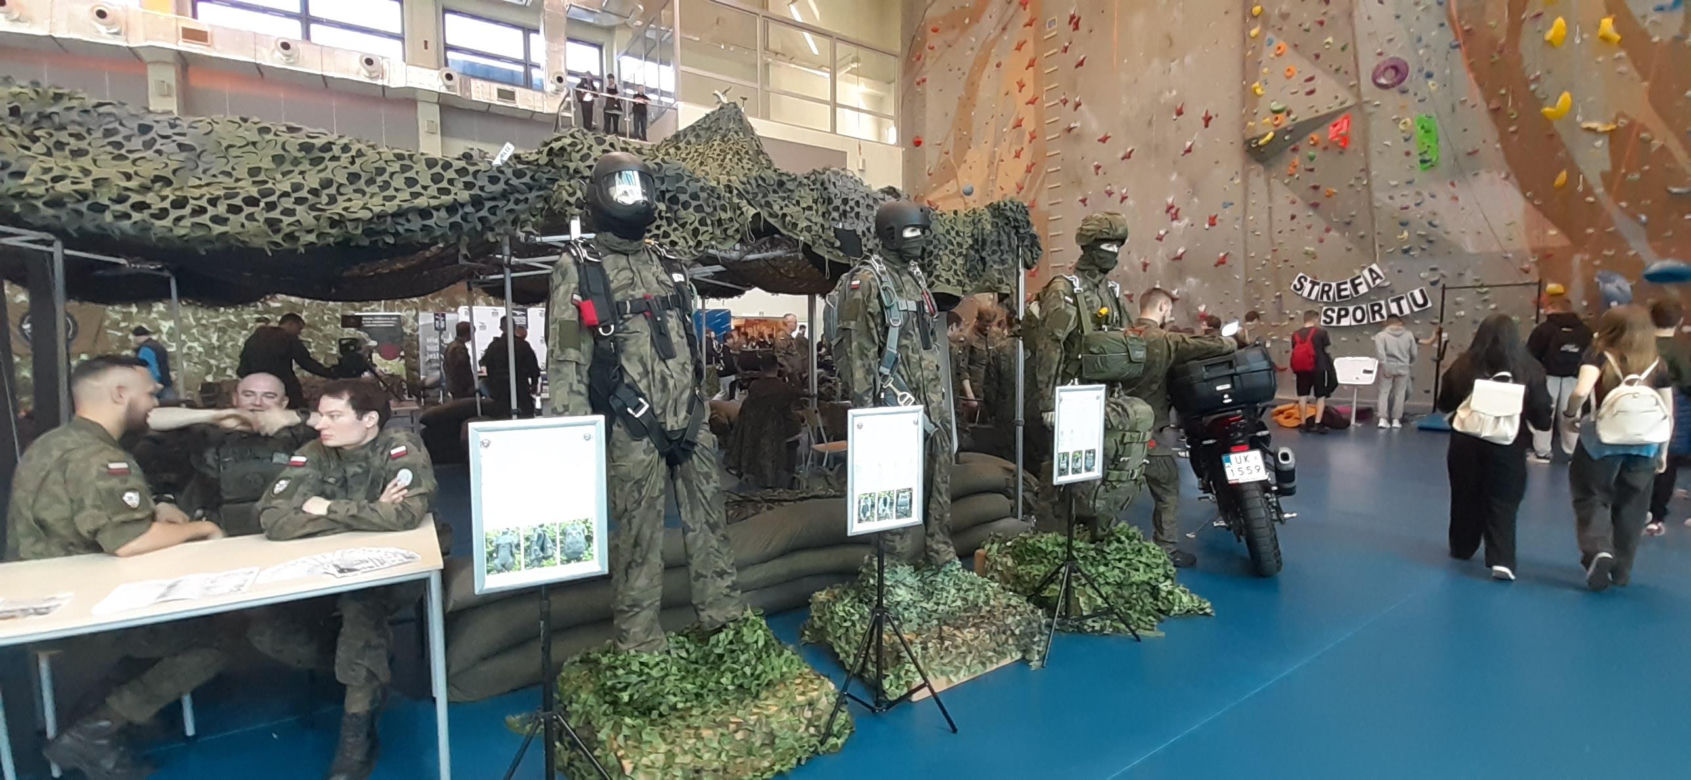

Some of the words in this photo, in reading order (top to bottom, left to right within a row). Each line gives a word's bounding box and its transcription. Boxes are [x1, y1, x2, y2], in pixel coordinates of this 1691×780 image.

[1292, 267, 1384, 301] STREFA
[1321, 288, 1429, 325] SPORTU
[1230, 464, 1261, 477] 1559
[1234, 454, 1250, 465] UK
